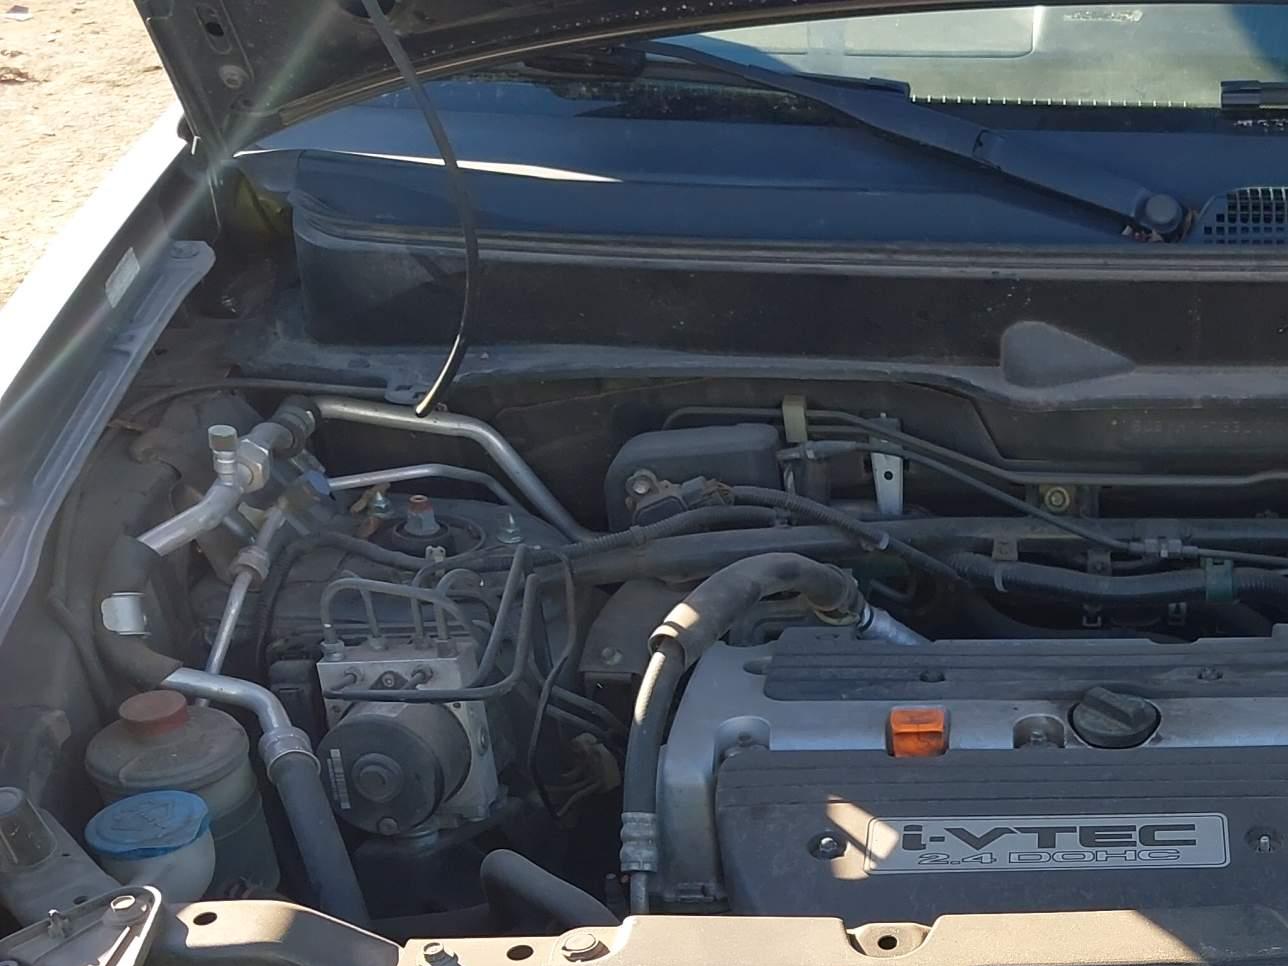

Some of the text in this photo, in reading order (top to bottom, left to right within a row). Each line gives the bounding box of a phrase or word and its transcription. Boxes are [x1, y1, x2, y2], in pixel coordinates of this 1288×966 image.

[902, 824, 1197, 851] i-VTEC
[917, 849, 1181, 866] 2.4 DOHC
